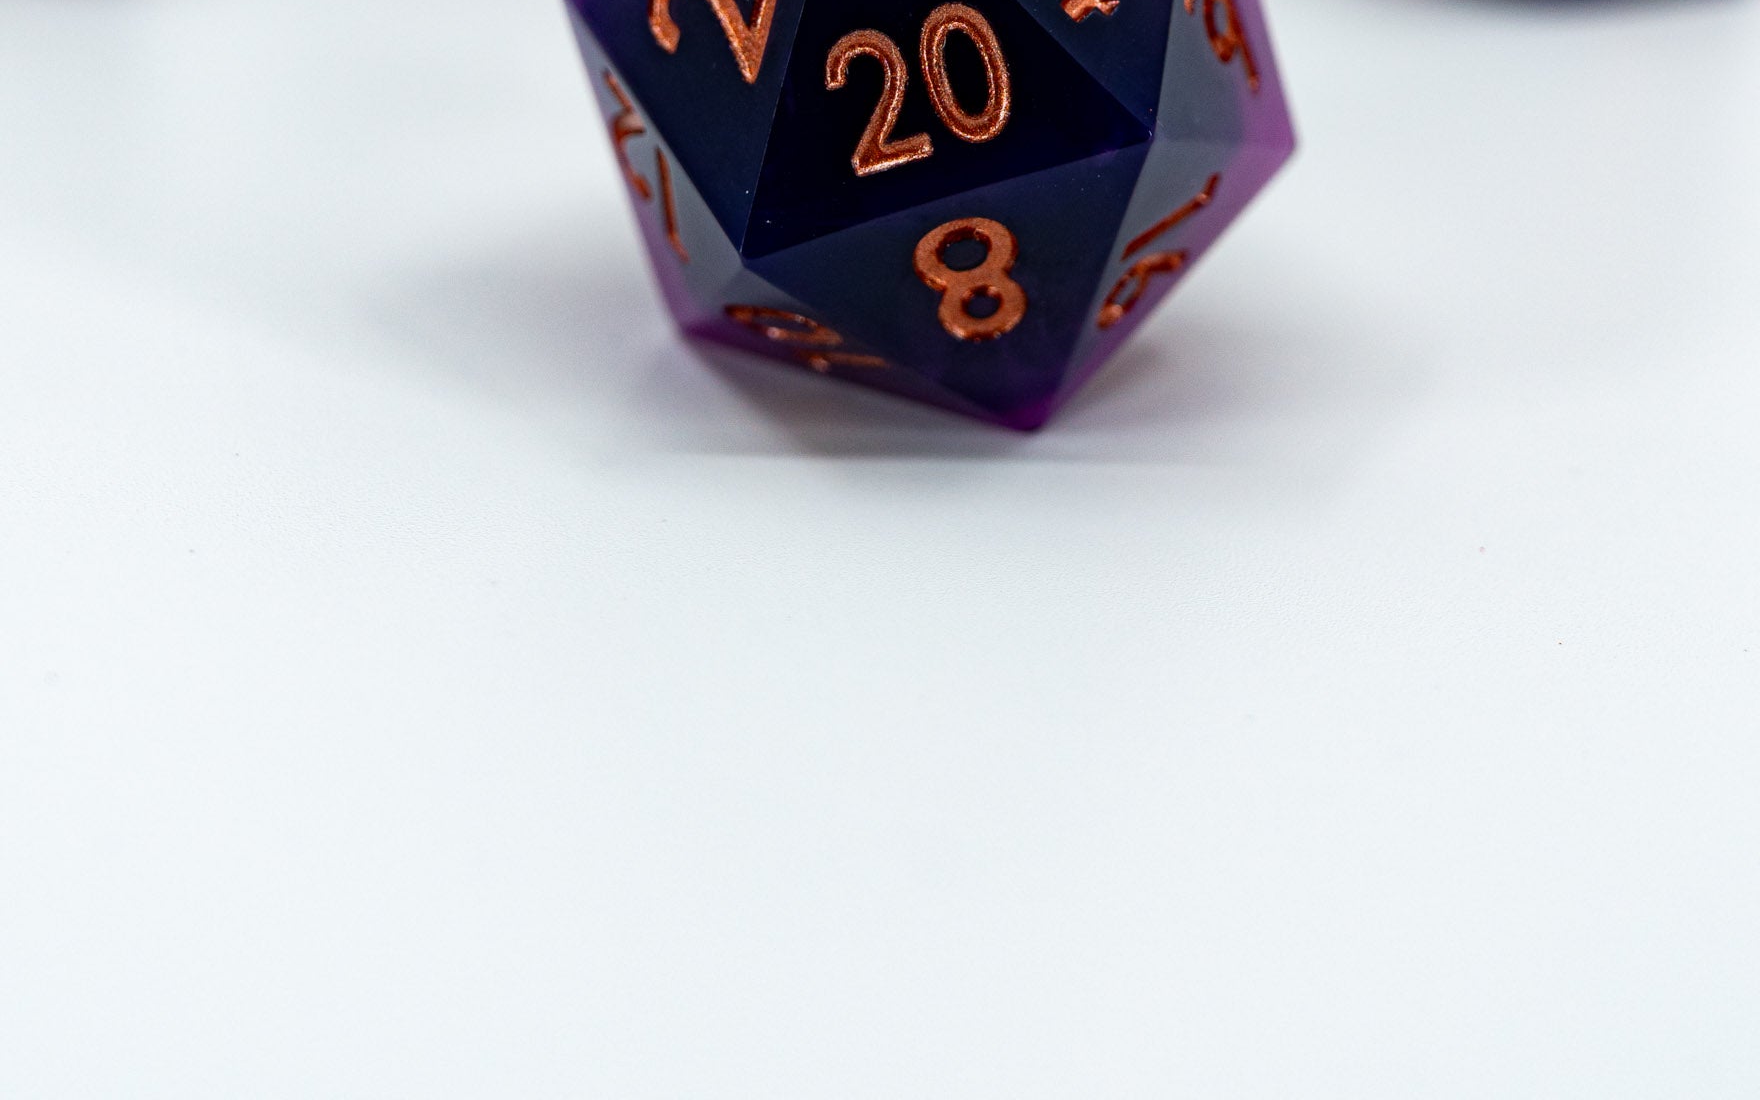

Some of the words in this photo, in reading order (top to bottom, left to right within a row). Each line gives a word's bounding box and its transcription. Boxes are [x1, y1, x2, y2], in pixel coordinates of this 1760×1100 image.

[604, 70, 688, 261] 12
[826, 2, 1011, 177] 20
[913, 217, 1028, 341] 8
[1097, 174, 1220, 329] 16
[725, 304, 888, 372] 10
